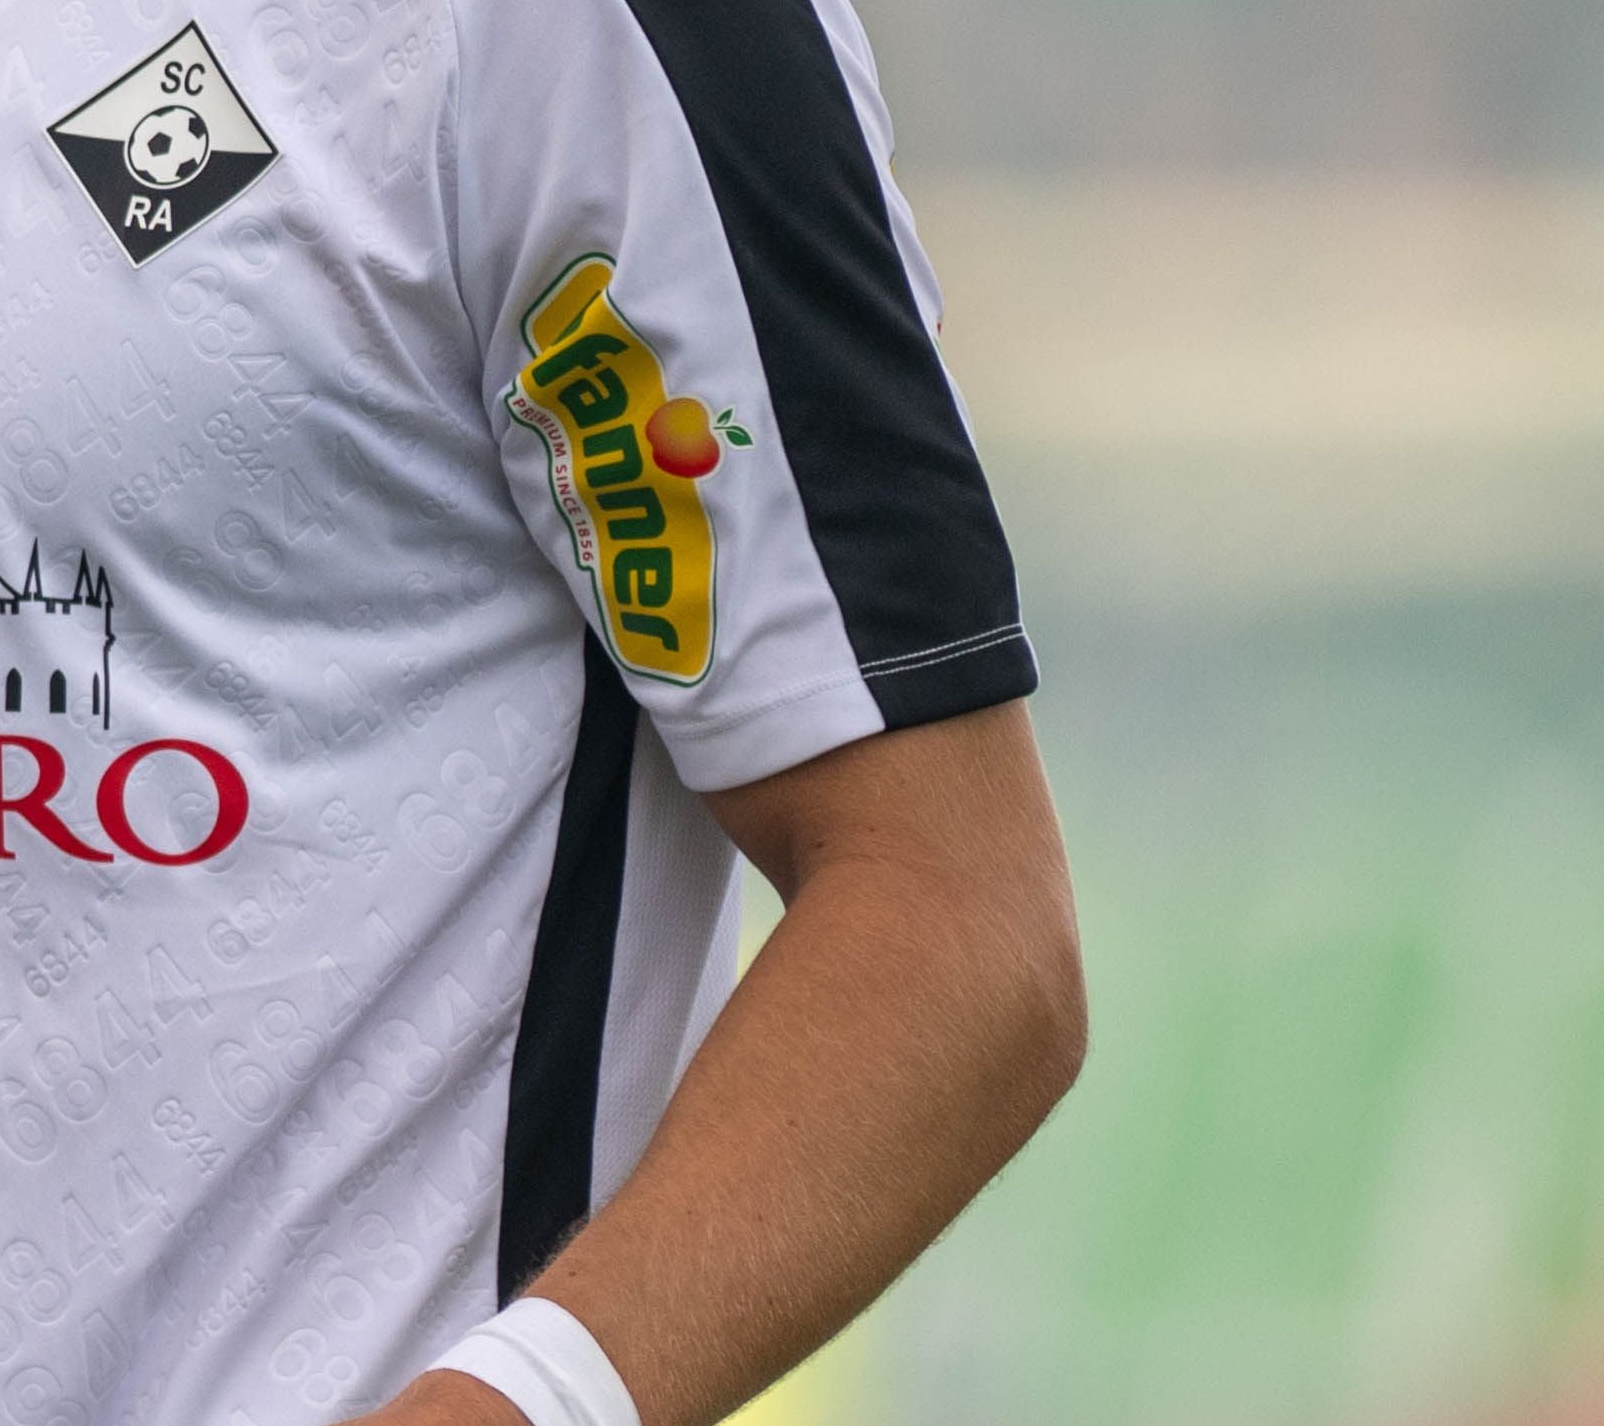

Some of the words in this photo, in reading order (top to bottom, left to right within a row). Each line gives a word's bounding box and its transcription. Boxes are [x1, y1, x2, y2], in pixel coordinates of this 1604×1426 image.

[160, 61, 206, 96] SC
[124, 194, 173, 232] RA
[512, 397, 566, 459] PREMIUM
[555, 463, 581, 517] SINCE
[575, 518, 595, 563] 1856
